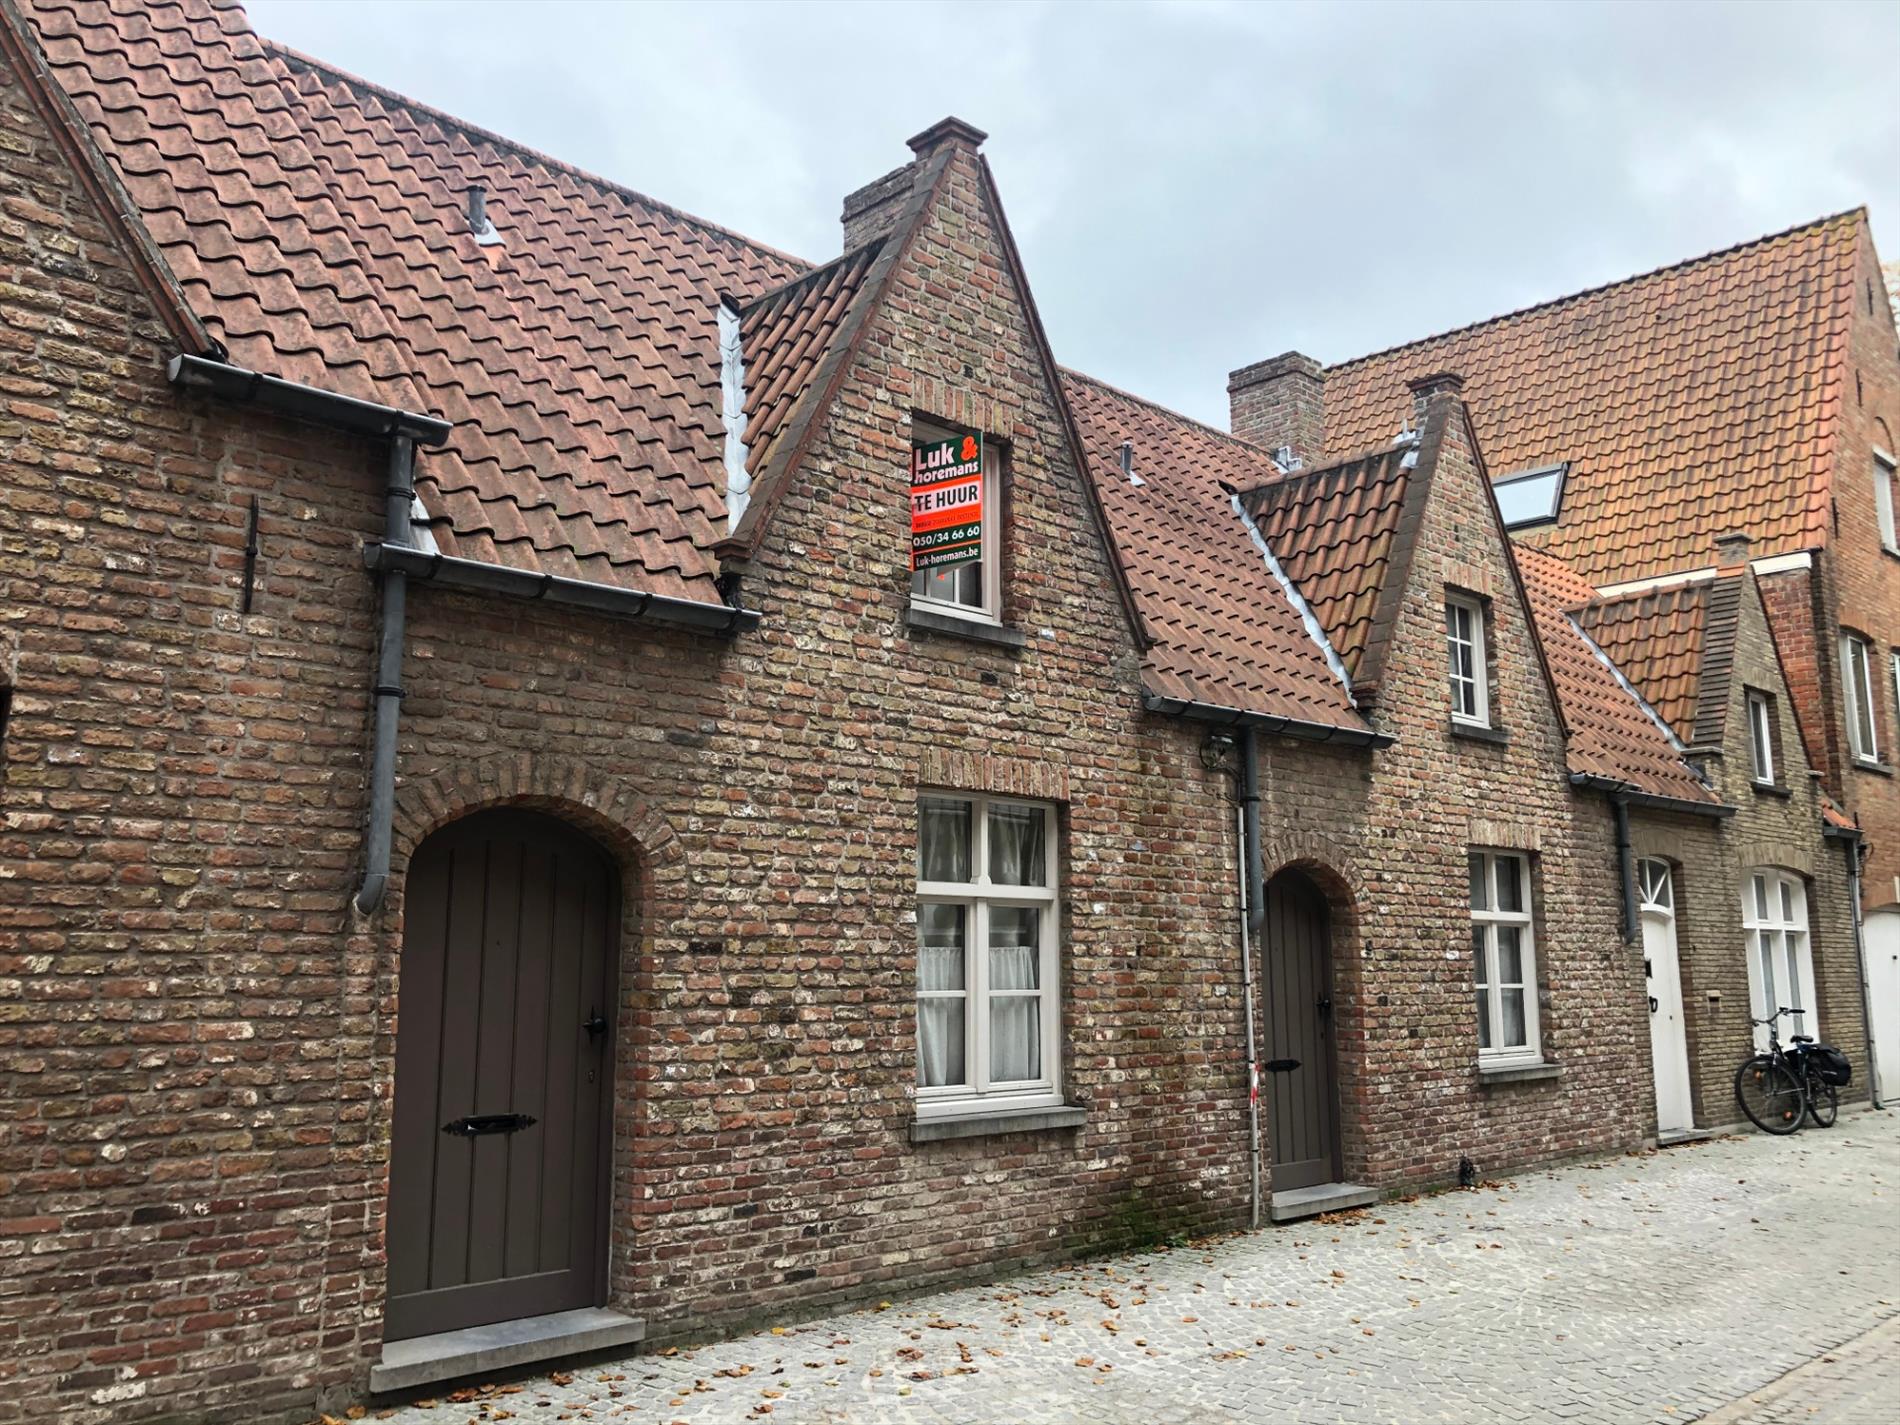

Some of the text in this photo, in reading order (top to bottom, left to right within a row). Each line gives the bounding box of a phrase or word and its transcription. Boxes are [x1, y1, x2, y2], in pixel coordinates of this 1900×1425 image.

[915, 435, 978, 471] Luk &
[914, 461, 979, 484] horemans
[914, 484, 978, 512] TE HUUR
[912, 525, 980, 547] 050/34 66 60
[915, 546, 979, 567] Luk-horemans.be
